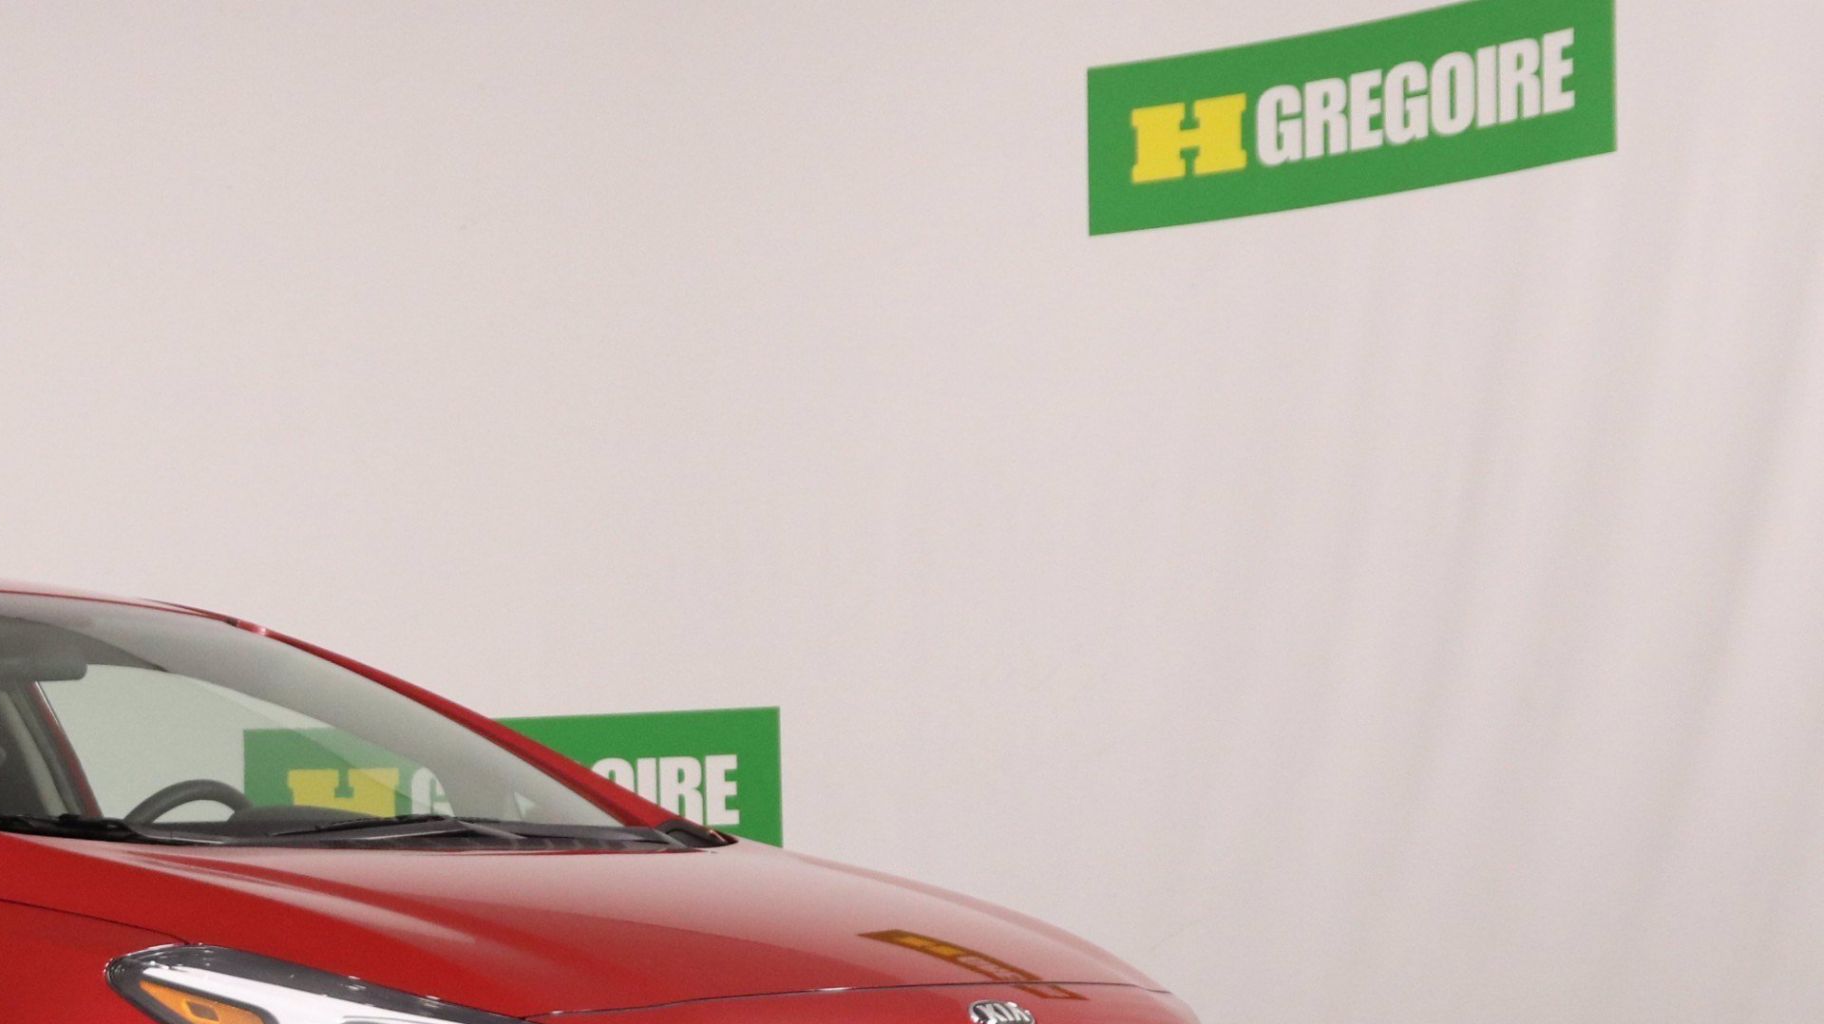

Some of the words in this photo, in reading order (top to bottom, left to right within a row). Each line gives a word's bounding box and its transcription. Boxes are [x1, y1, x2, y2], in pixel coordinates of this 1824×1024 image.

[1130, 92, 1248, 185] H
[1255, 27, 1575, 167] GREGOIRE
[975, 1002, 1031, 1022] KIA
